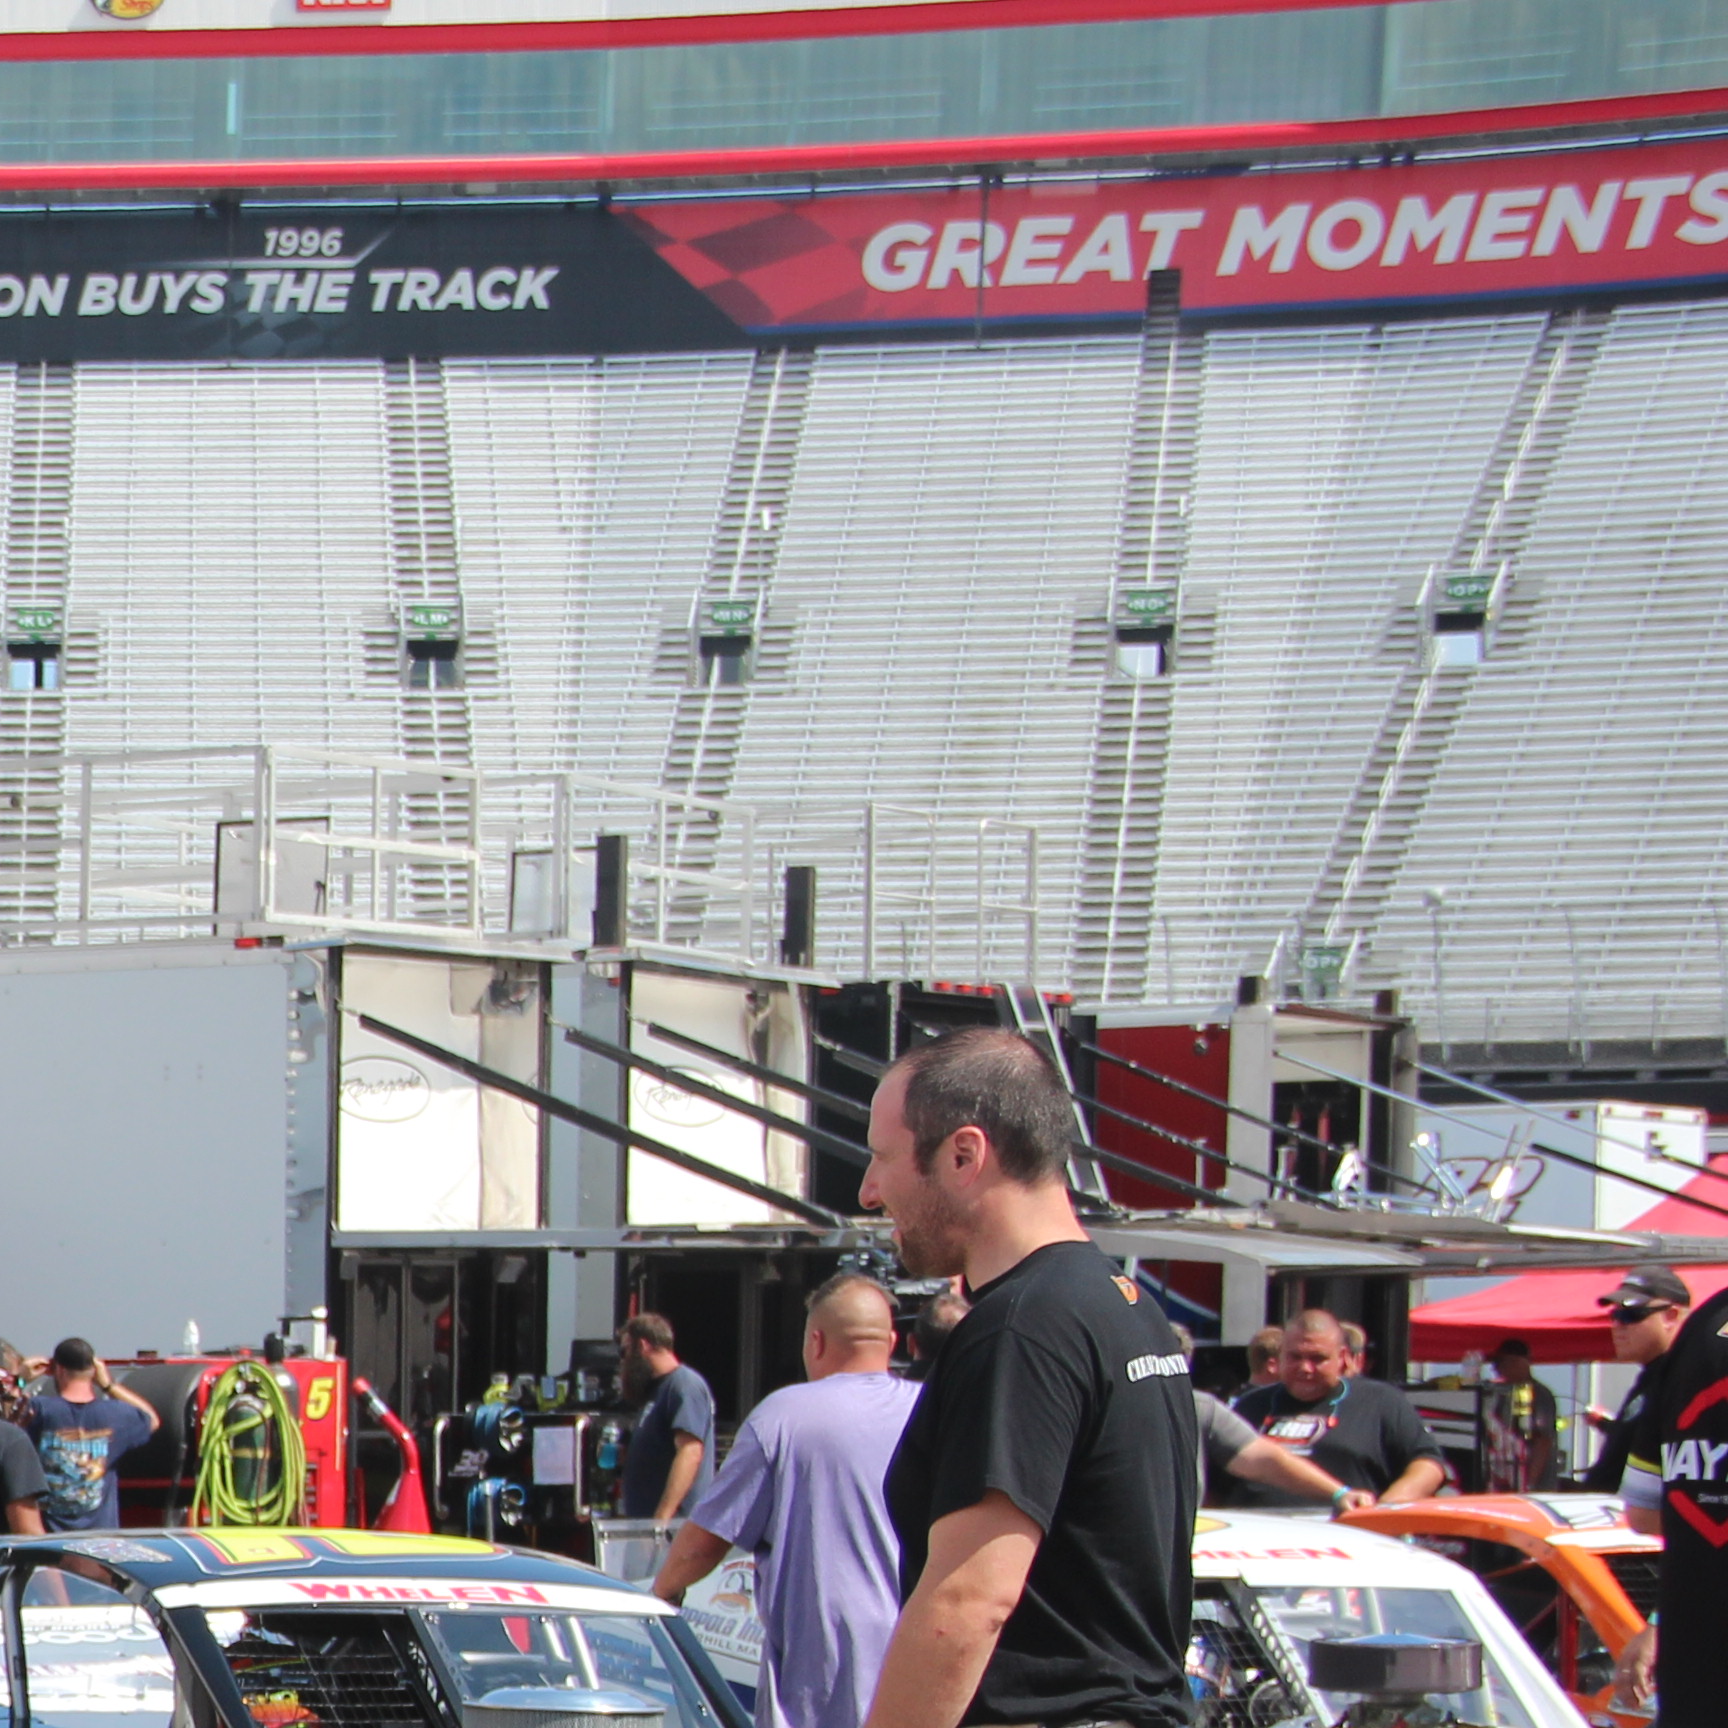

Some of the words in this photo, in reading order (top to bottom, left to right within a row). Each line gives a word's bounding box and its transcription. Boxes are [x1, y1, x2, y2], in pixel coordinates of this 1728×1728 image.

[263, 228, 343, 257] 1996
[861, 208, 1205, 293] GREAT
[1216, 174, 1728, 277] MOMENTS
[77, 272, 228, 316] BUYS
[243, 269, 356, 313] THE
[369, 266, 559, 312] TRACK
[305, 1377, 334, 1421] 5
[1190, 1546, 1355, 1561] HELEN
[288, 1581, 550, 1605] WHELEN
